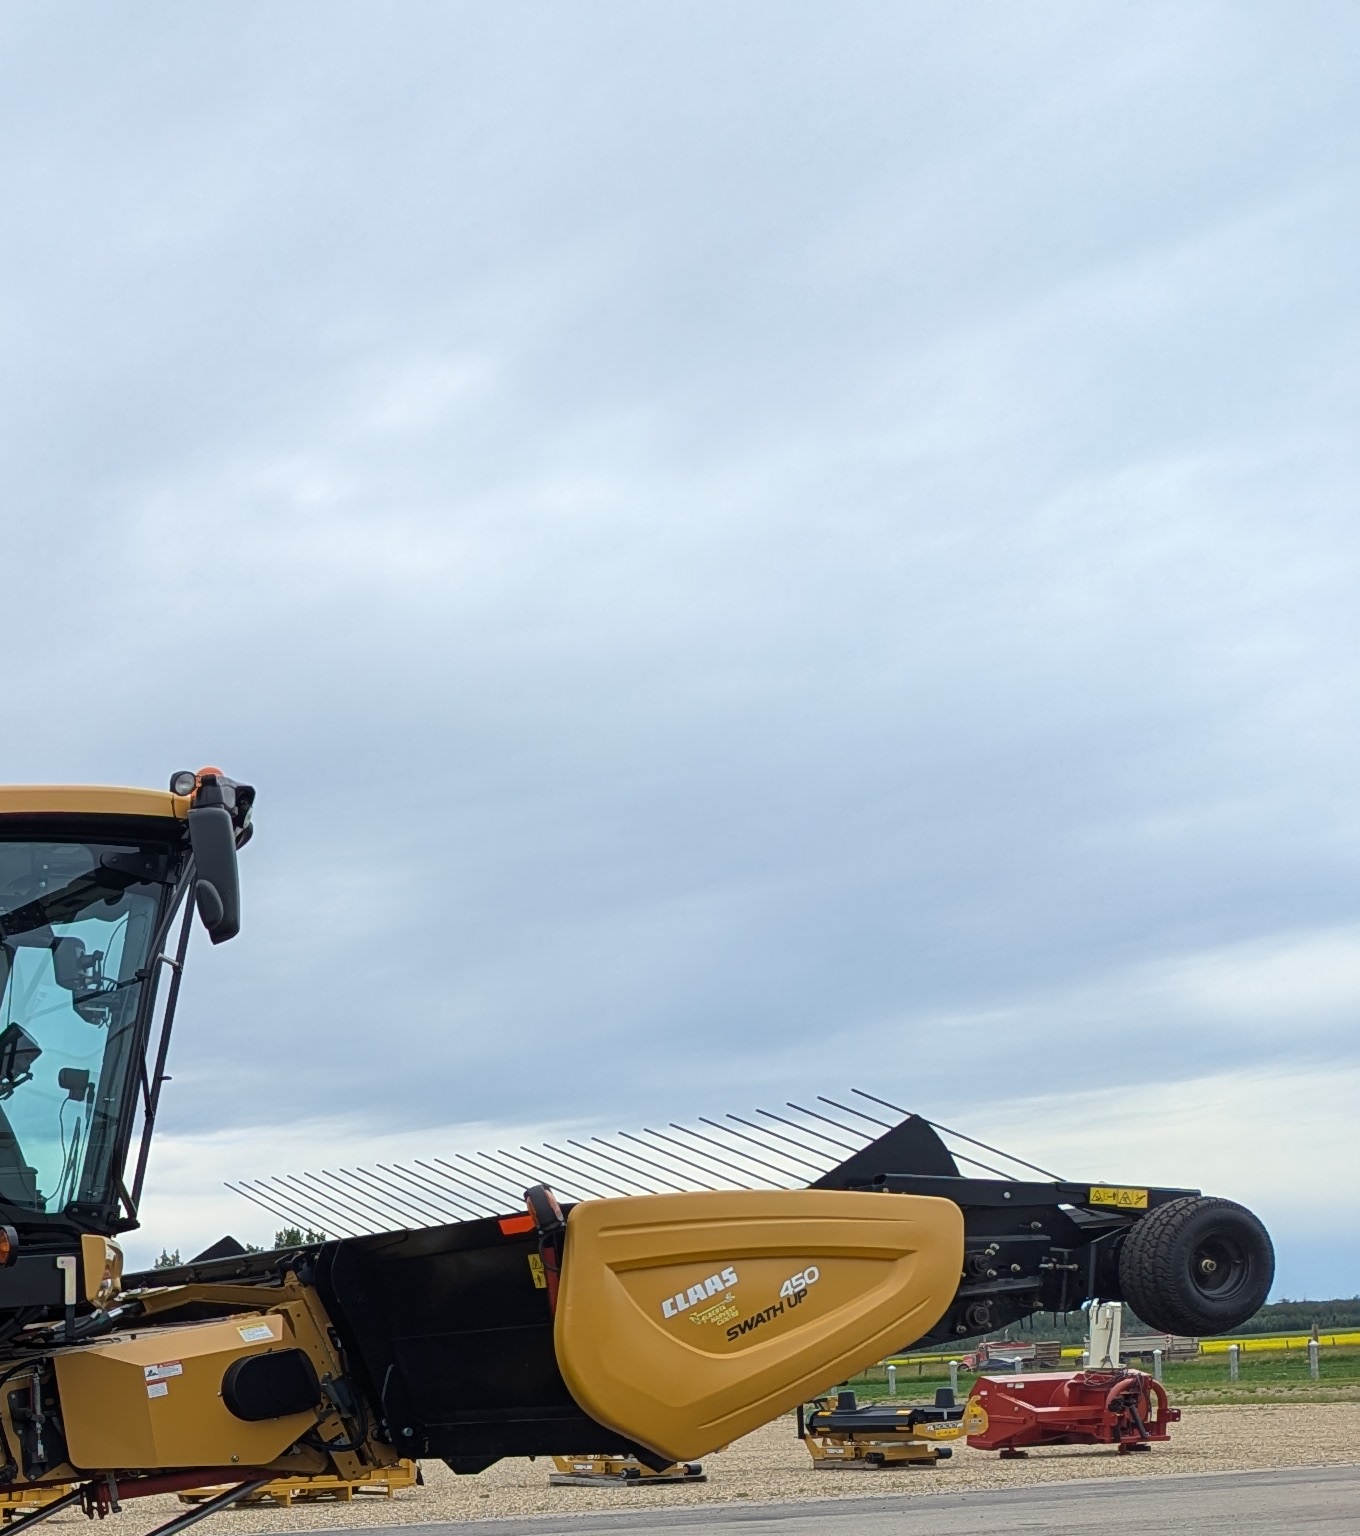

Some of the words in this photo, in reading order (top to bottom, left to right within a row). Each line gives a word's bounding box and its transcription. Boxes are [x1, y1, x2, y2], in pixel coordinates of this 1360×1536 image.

[661, 1266, 739, 1319] CLAAS
[780, 1266, 820, 1298] 450
[726, 1301, 785, 1342] SWATH
[787, 1288, 808, 1309] UP
